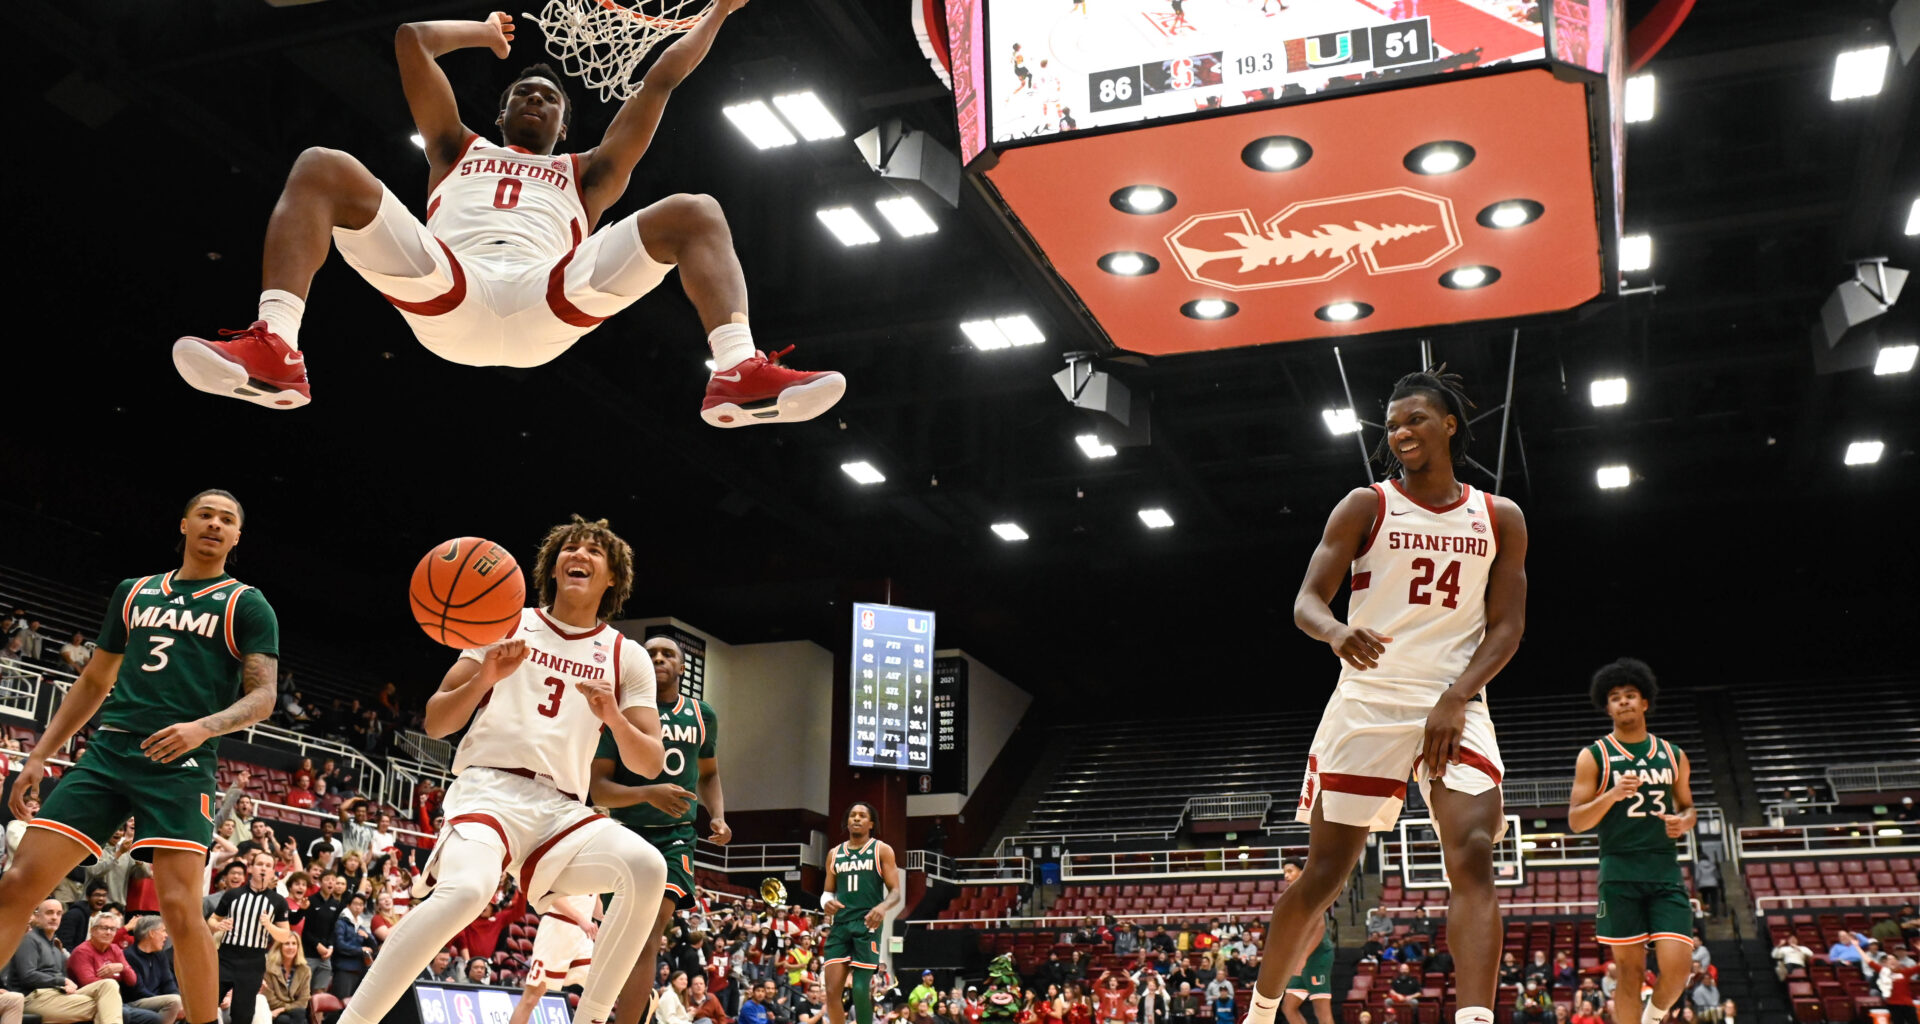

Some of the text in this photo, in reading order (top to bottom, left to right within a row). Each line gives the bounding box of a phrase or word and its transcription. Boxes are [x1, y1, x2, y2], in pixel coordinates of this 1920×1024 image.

[1099, 76, 1133, 103] 86
[1235, 53, 1273, 75] 19.3
[1385, 29, 1418, 58] 51
[461, 159, 569, 191] STANFORD
[493, 178, 523, 209] 0
[1389, 532, 1488, 557] STANFORD
[1408, 557, 1461, 610] 24
[130, 605, 219, 638] MIAMI
[141, 635, 175, 672] 3
[885, 640, 901, 650] PTS
[524, 648, 605, 680] TANFORD
[537, 677, 565, 719] 3
[862, 700, 872, 710] 11
[863, 684, 873, 694] 11
[914, 689, 922, 699] 7
[661, 724, 698, 744] AMI
[1612, 768, 1673, 785] MAMI
[1627, 790, 1667, 818] 23
[835, 859, 874, 874] MIAMI
[847, 874, 859, 892] 11
[421, 998, 445, 1024] 86
